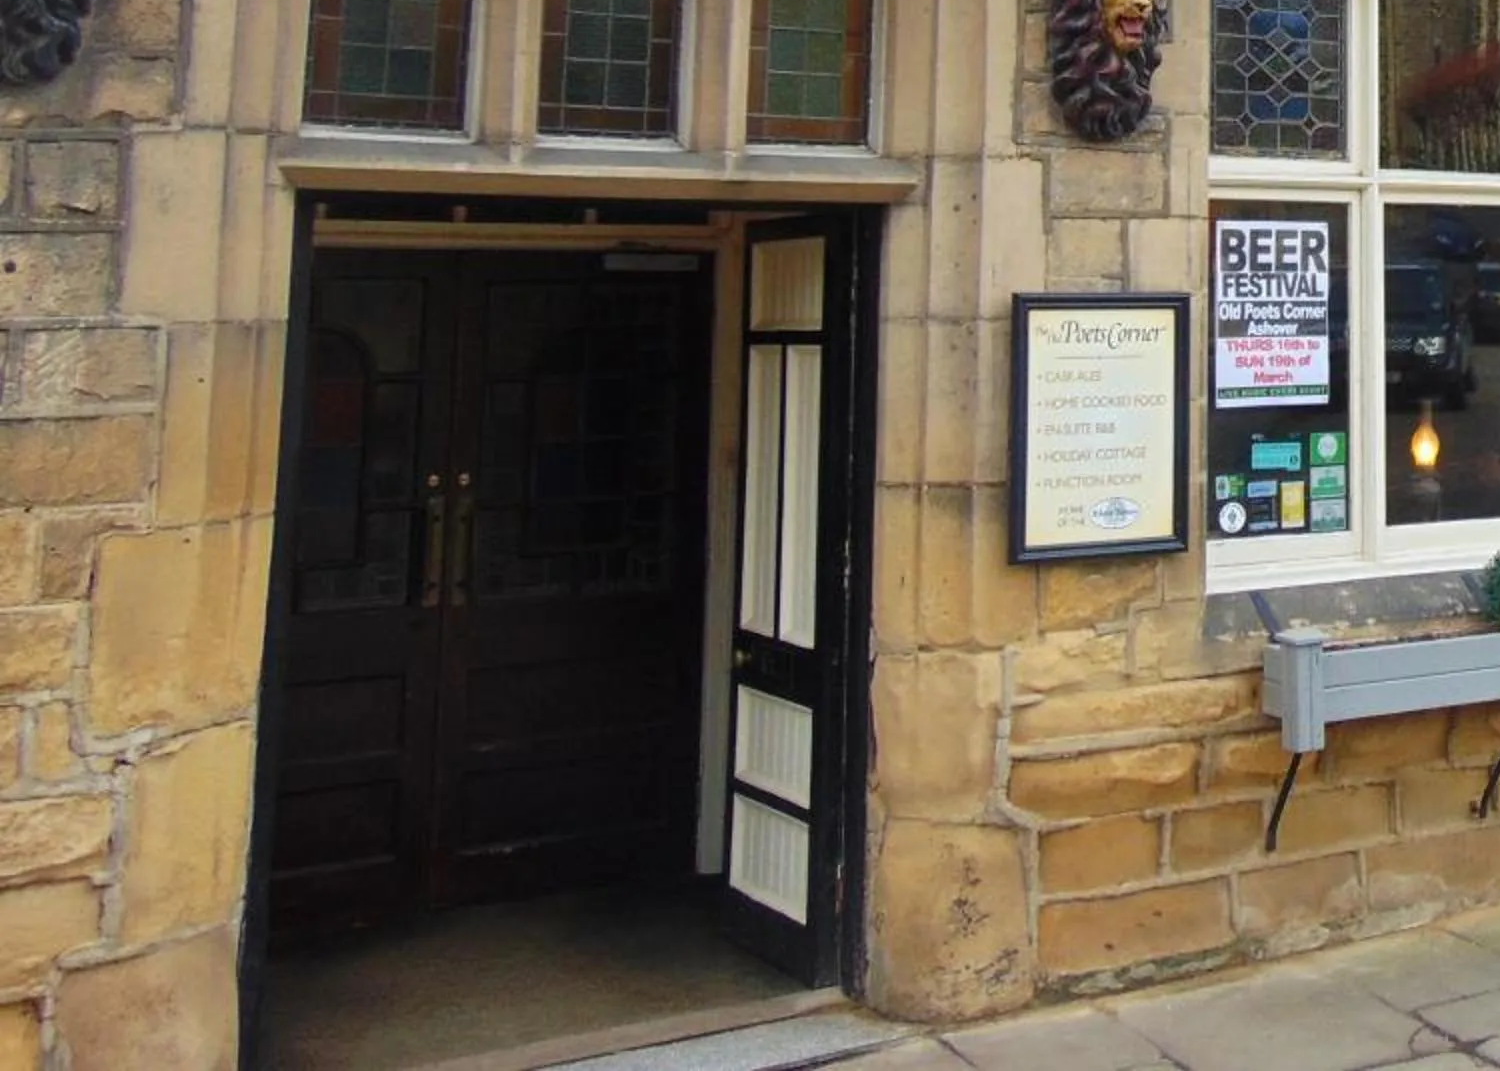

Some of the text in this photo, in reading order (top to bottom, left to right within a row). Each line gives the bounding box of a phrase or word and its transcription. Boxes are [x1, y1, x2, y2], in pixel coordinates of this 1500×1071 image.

[1220, 228, 1327, 272] BEER
[1222, 273, 1325, 298] FESTIVAL
[1219, 303, 1327, 320] Old Poets Corner
[1060, 320, 1107, 345] Poets
[1106, 321, 1167, 350] Corner
[1247, 321, 1299, 336] Ashover
[1226, 340, 1273, 352] THURS
[1307, 339, 1321, 350] to
[1235, 355, 1312, 368] SUN 19th of
[1253, 371, 1293, 384] March
[1044, 394, 1167, 410] HOME COOKED FOOD
[1044, 446, 1146, 463] HOLIDAY COTTAGE
[1043, 473, 1143, 489] FUNCTION ROOM
